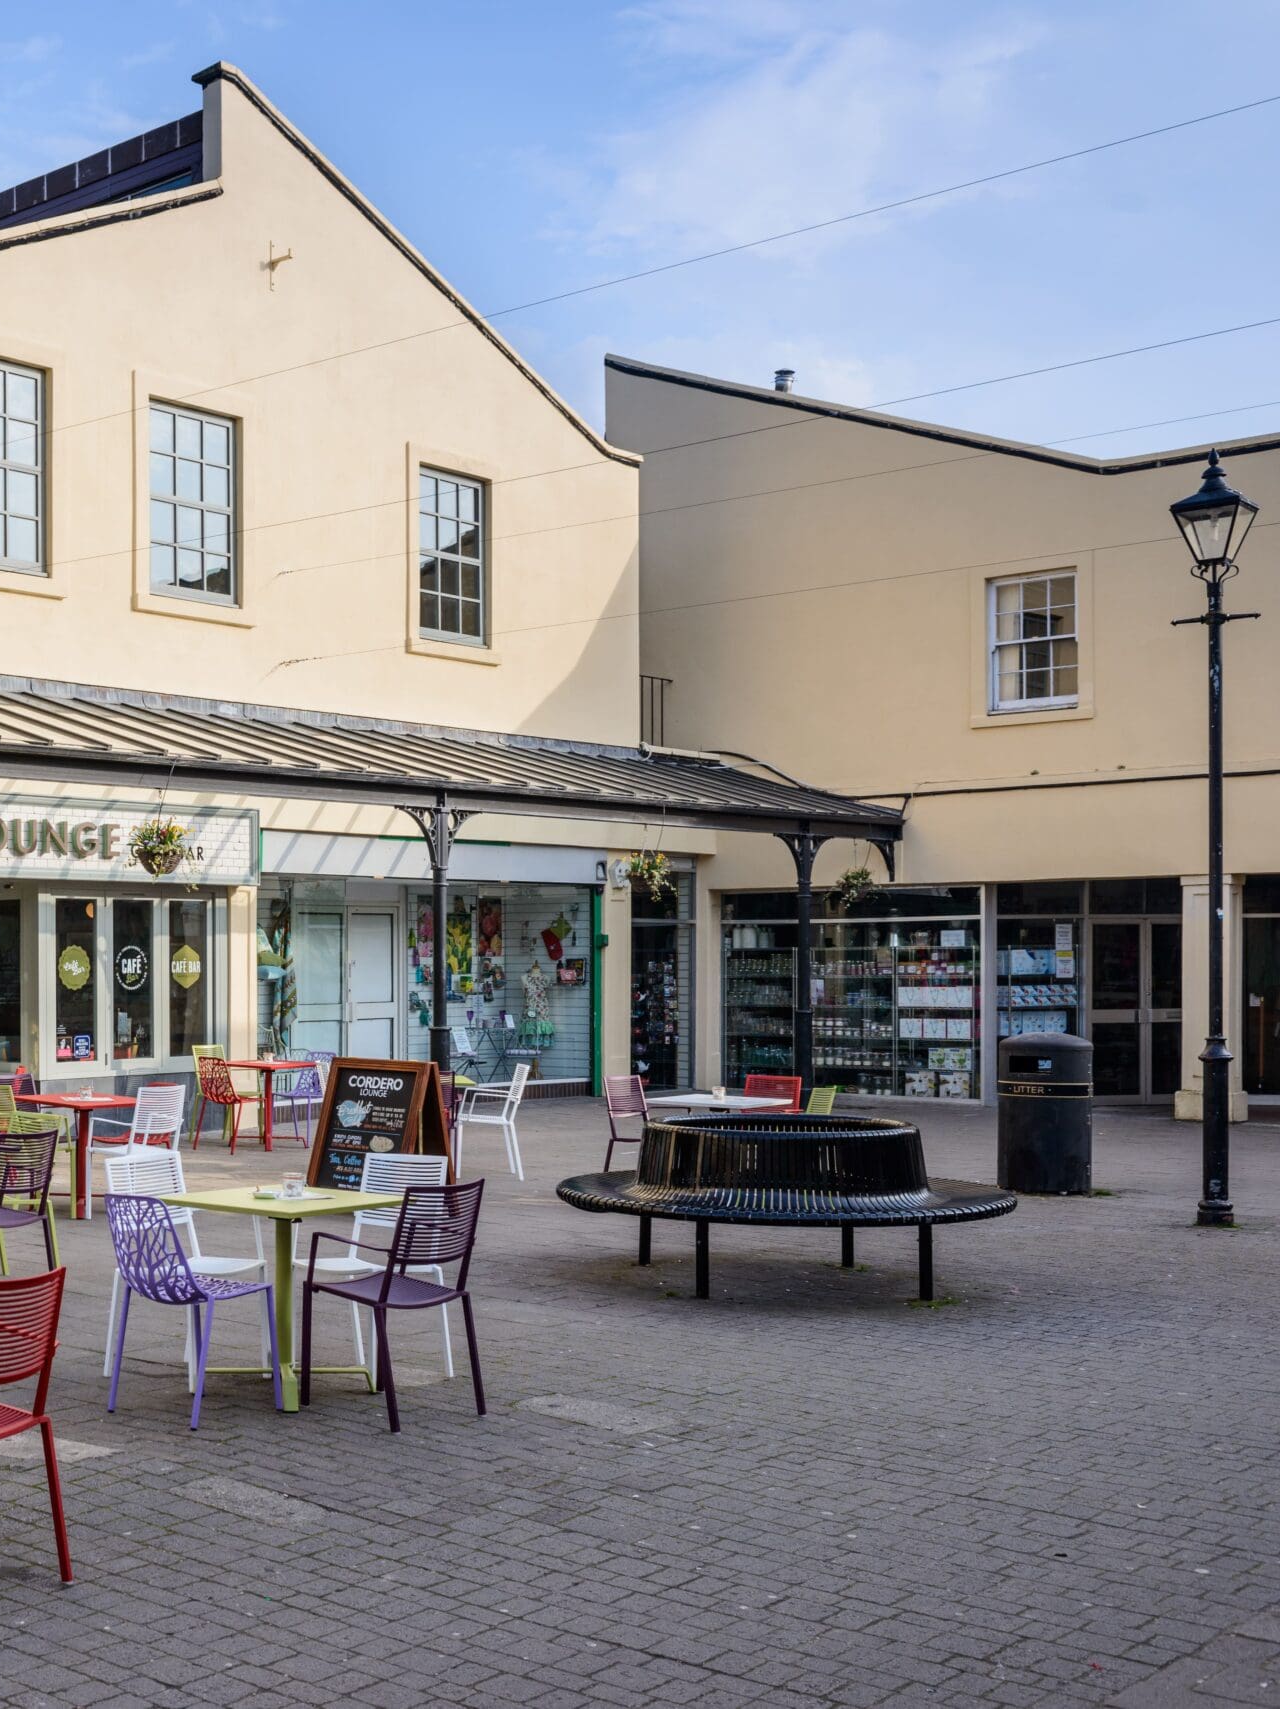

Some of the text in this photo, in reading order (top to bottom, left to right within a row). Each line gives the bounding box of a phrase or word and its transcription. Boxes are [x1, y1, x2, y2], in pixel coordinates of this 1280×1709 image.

[121, 955, 142, 974] CAFÉ
[171, 958, 201, 973] CAFÉ BAR
[348, 1075, 404, 1091] CORDERO
[1013, 1085, 1045, 1094] LITTER
[360, 1088, 388, 1098] LOUNGE
